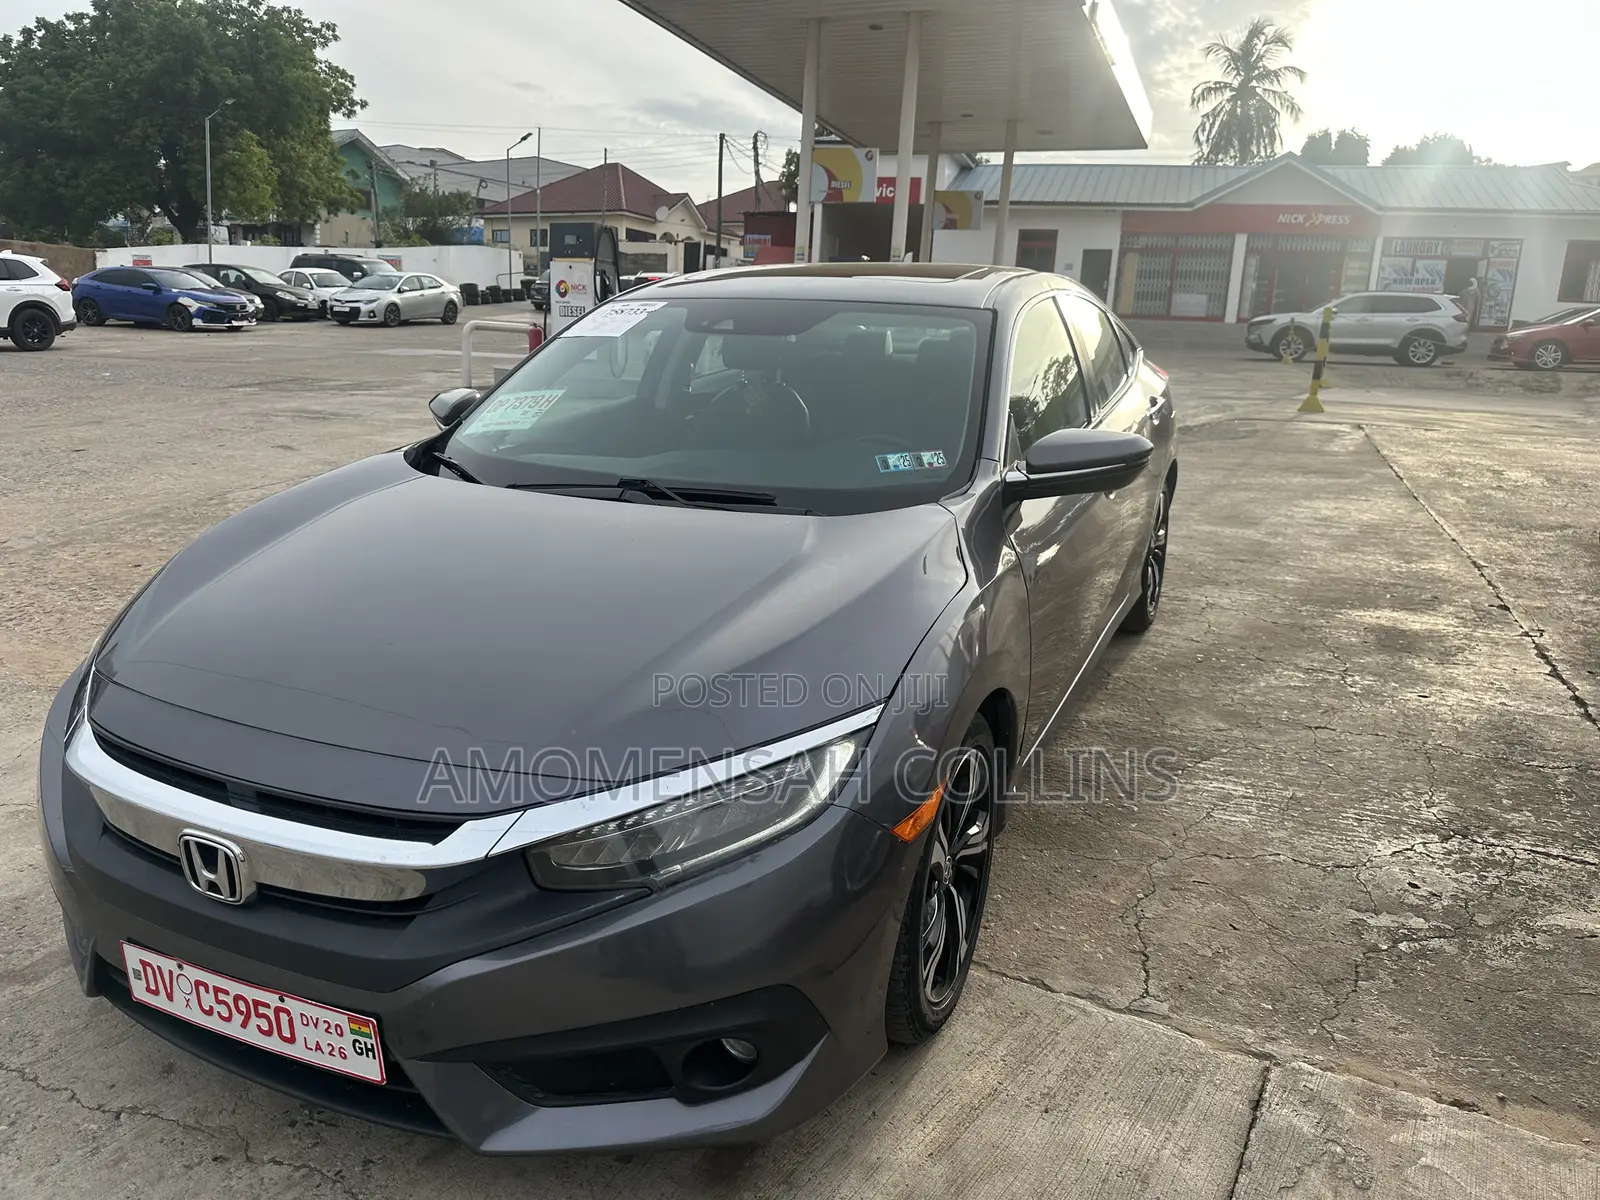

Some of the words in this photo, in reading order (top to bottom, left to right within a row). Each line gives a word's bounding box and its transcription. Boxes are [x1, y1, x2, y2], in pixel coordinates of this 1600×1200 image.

[830, 180, 852, 189] DIESEL
[875, 183, 895, 198] vic
[1277, 213, 1306, 224] NICK
[1305, 210, 1351, 228] XPRESS
[1393, 240, 1440, 255] LAUNDRY
[570, 283, 588, 292] NICK
[1392, 277, 1413, 286] NOW
[1414, 277, 1437, 286] OPEN
[559, 305, 586, 317] DIESEL
[139, 958, 174, 1003] DV
[193, 978, 297, 1045] C5950
[300, 1012, 320, 1031] DV
[323, 1018, 345, 1038] 20
[303, 1035, 325, 1056] LA
[328, 1043, 349, 1061] 26
[351, 1038, 377, 1061] GH
